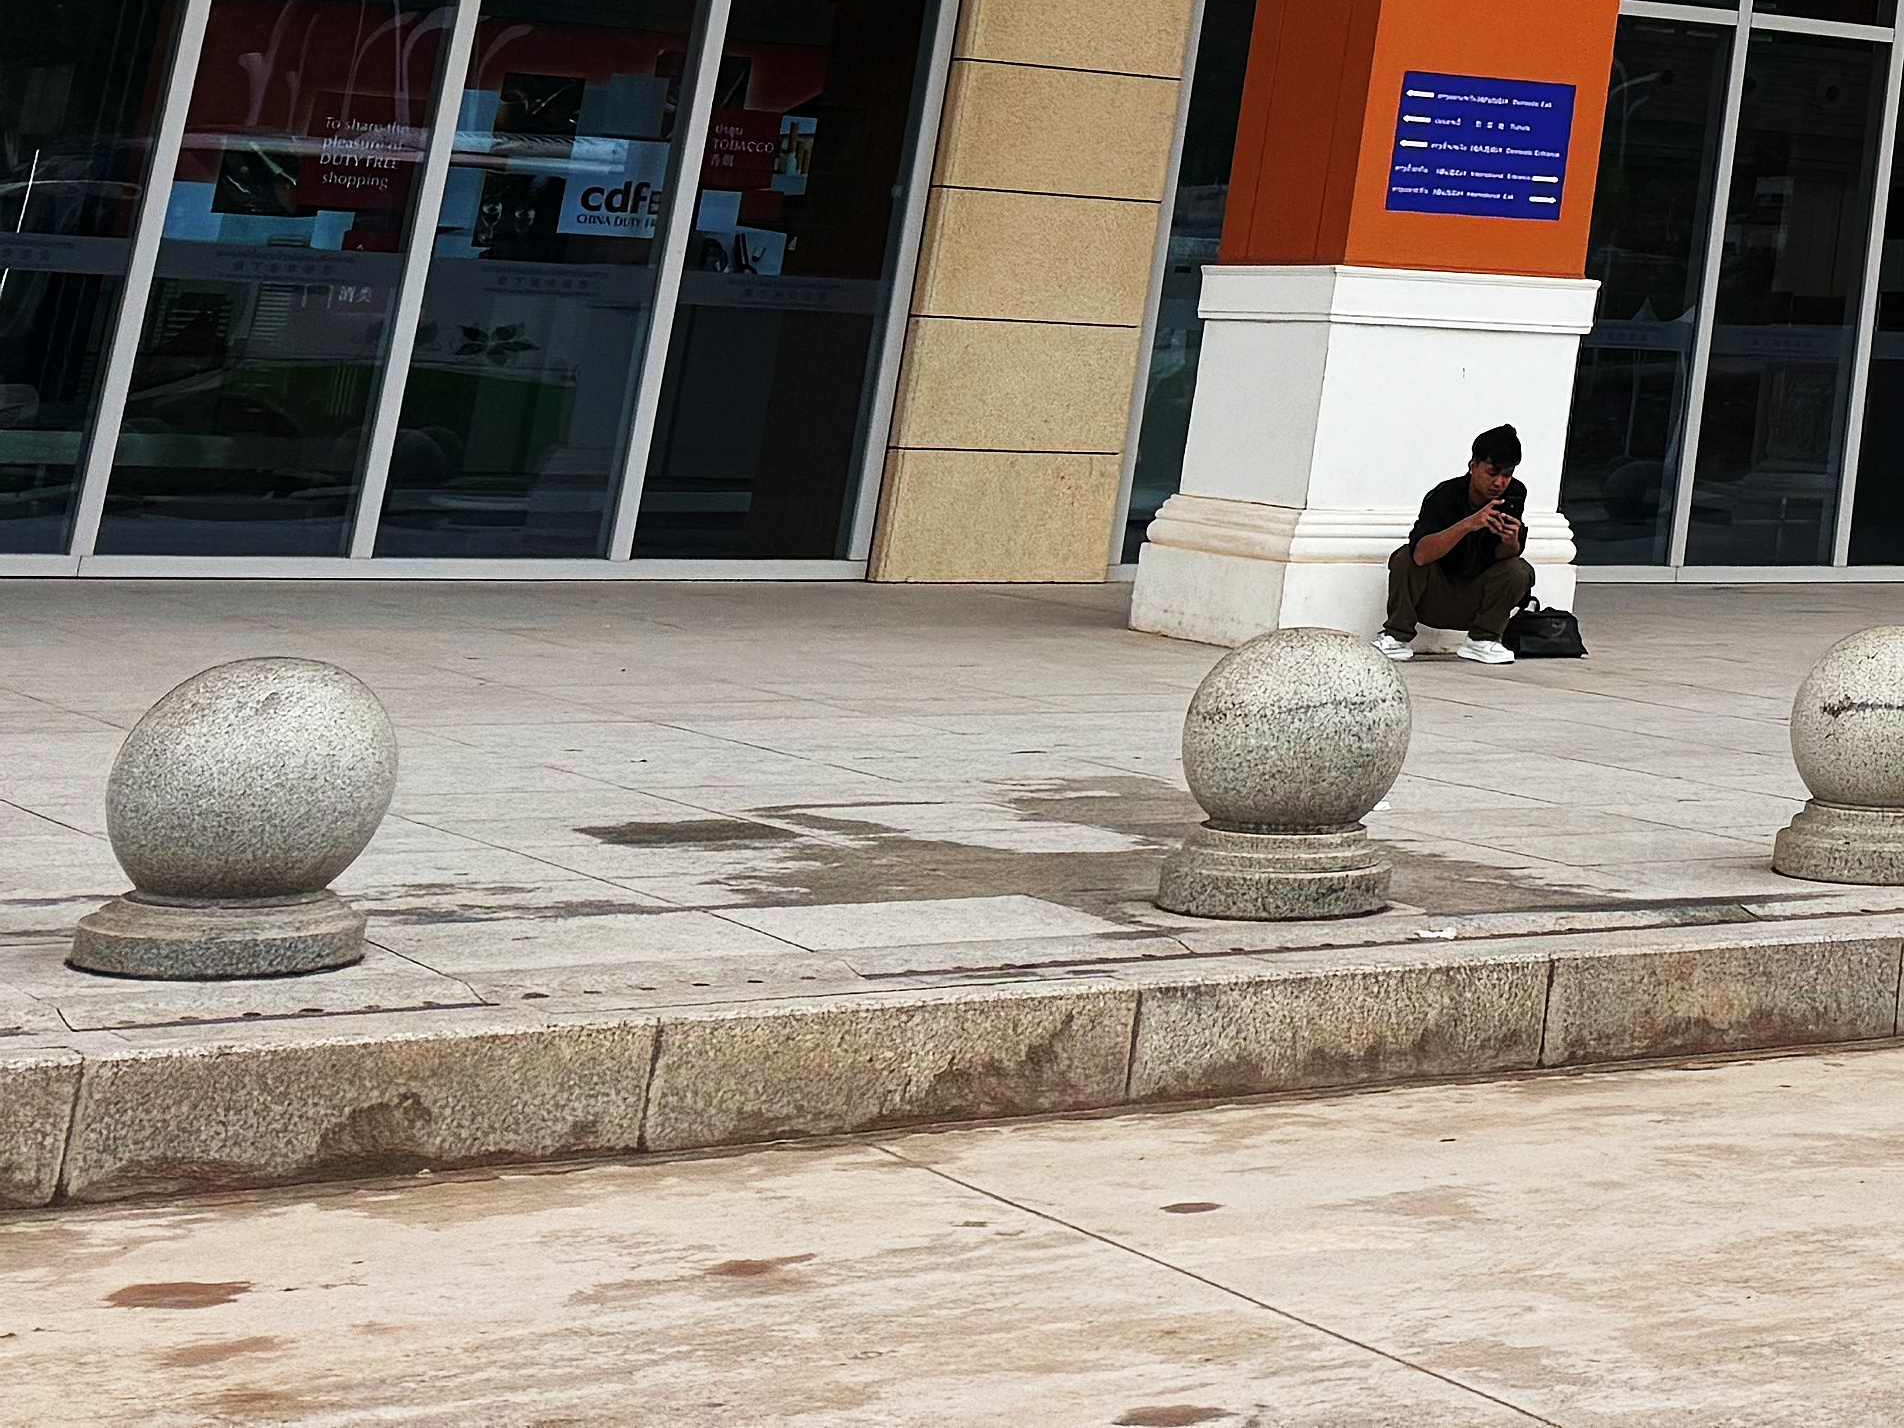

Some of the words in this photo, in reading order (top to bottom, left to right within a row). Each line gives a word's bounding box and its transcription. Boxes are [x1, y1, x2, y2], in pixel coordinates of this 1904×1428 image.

[325, 116, 341, 129] To
[322, 133, 384, 151] pleasure
[319, 153, 363, 167] DUTY
[365, 155, 398, 170] FREE
[321, 171, 389, 191] shopping
